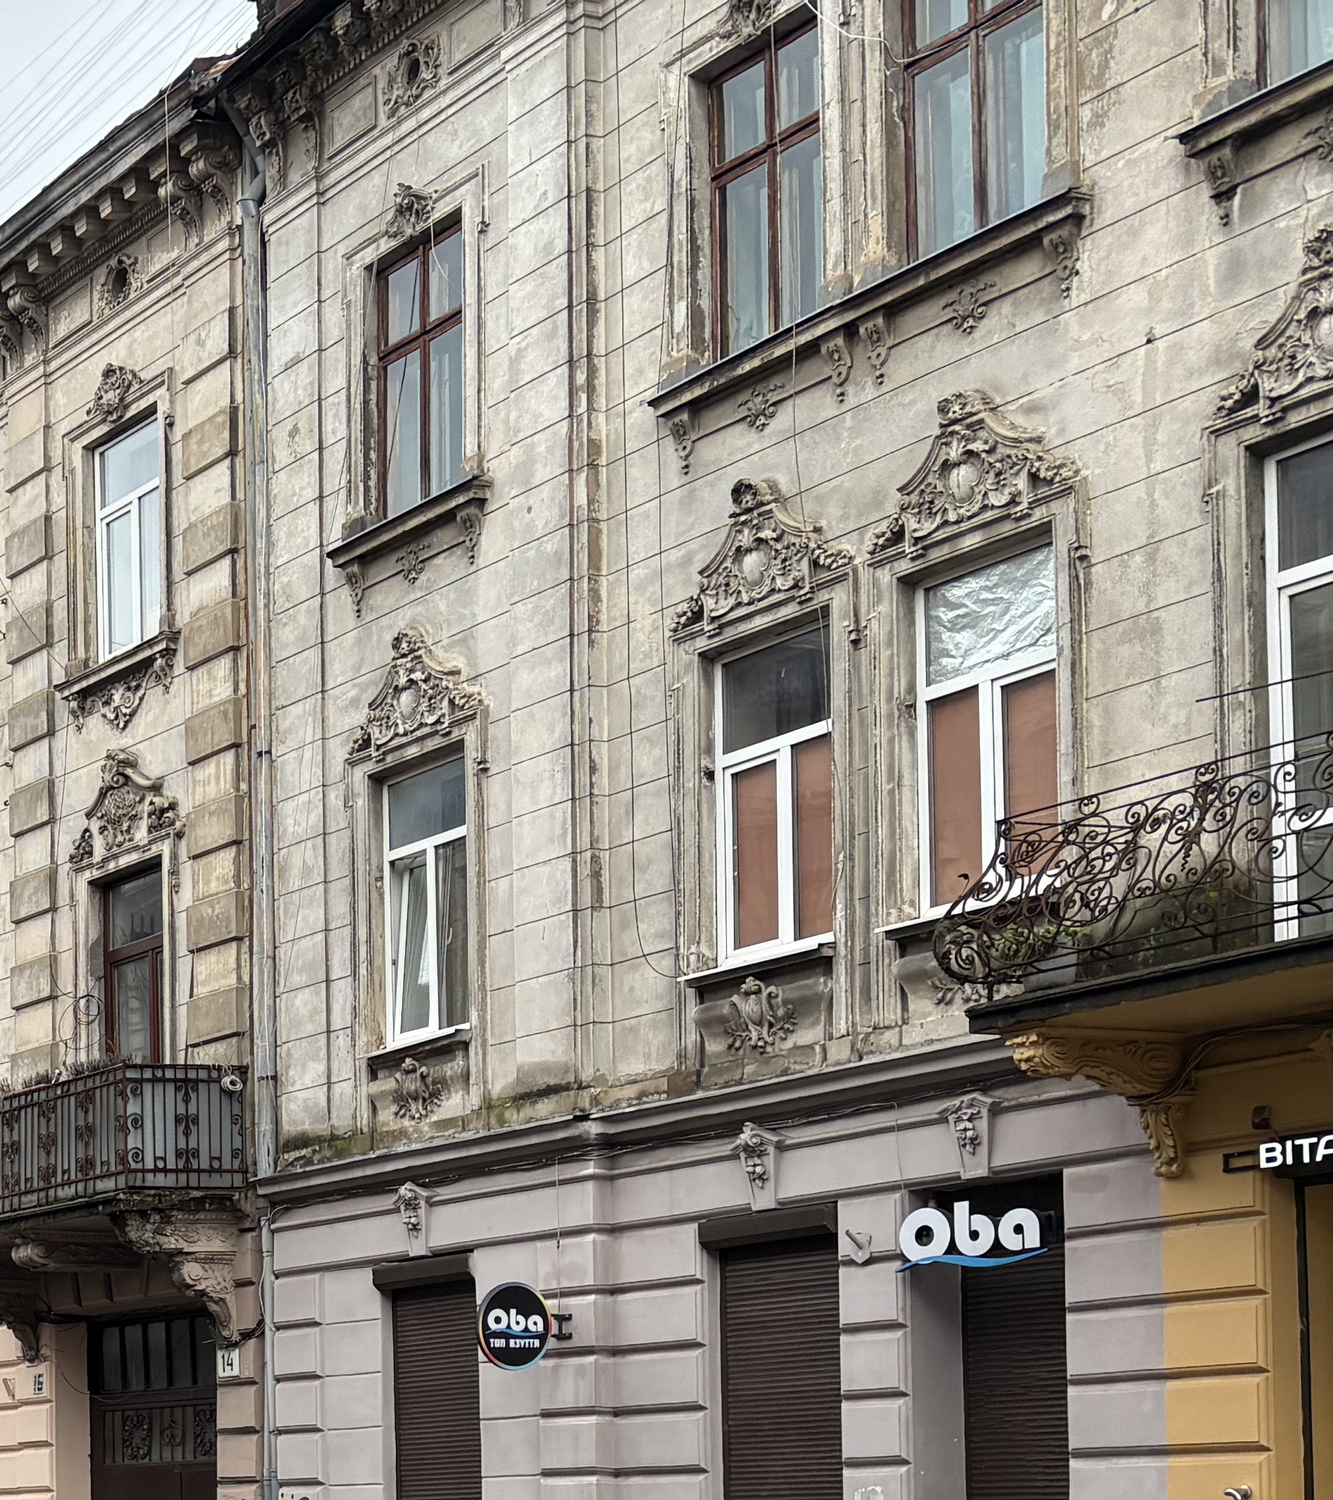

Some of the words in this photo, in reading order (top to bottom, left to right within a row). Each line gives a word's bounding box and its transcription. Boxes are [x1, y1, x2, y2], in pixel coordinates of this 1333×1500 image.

[899, 1200, 1041, 1264] Oba
[487, 1308, 544, 1332] Oba
[221, 1353, 234, 1373] 14
